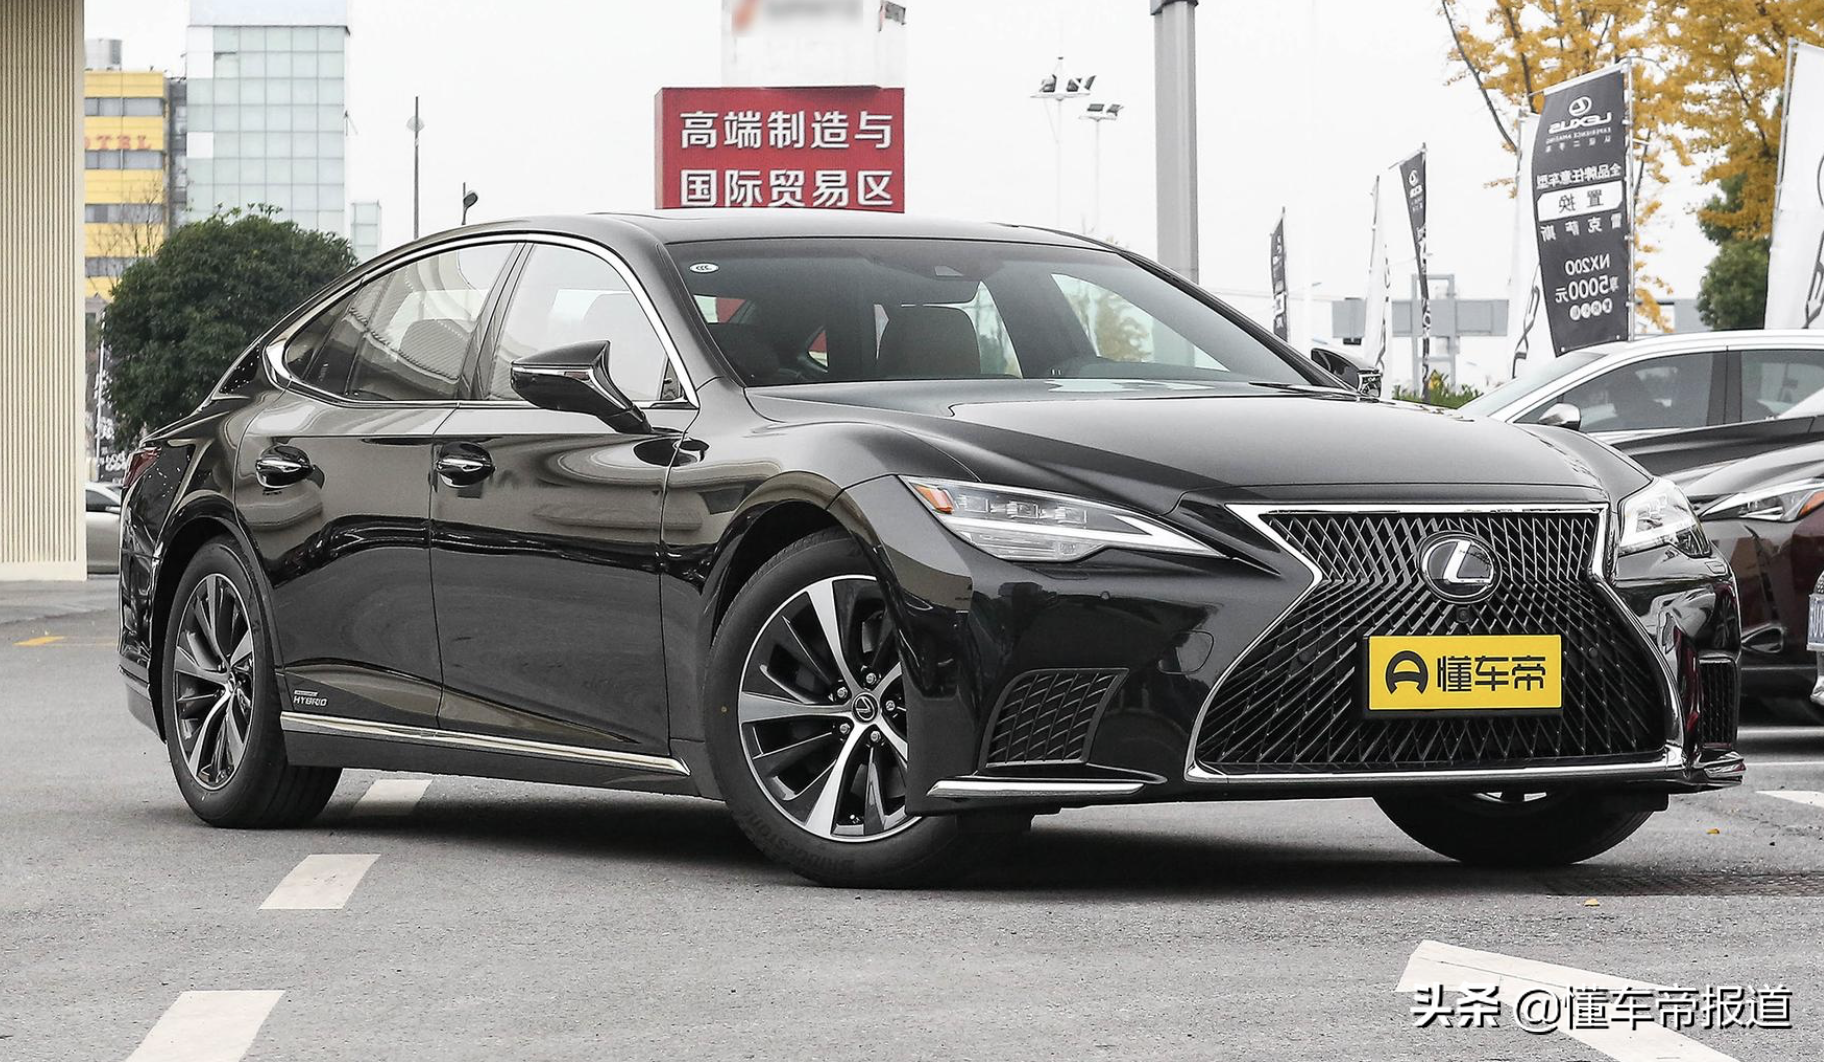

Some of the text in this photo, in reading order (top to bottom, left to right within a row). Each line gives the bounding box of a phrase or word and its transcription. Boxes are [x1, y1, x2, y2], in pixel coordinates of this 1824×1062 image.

[680, 110, 893, 149] 高端制造与
[680, 169, 893, 207] 国际贸易区
[1437, 655, 1546, 692] 懂车帝
[293, 695, 328, 707] HYBRID
